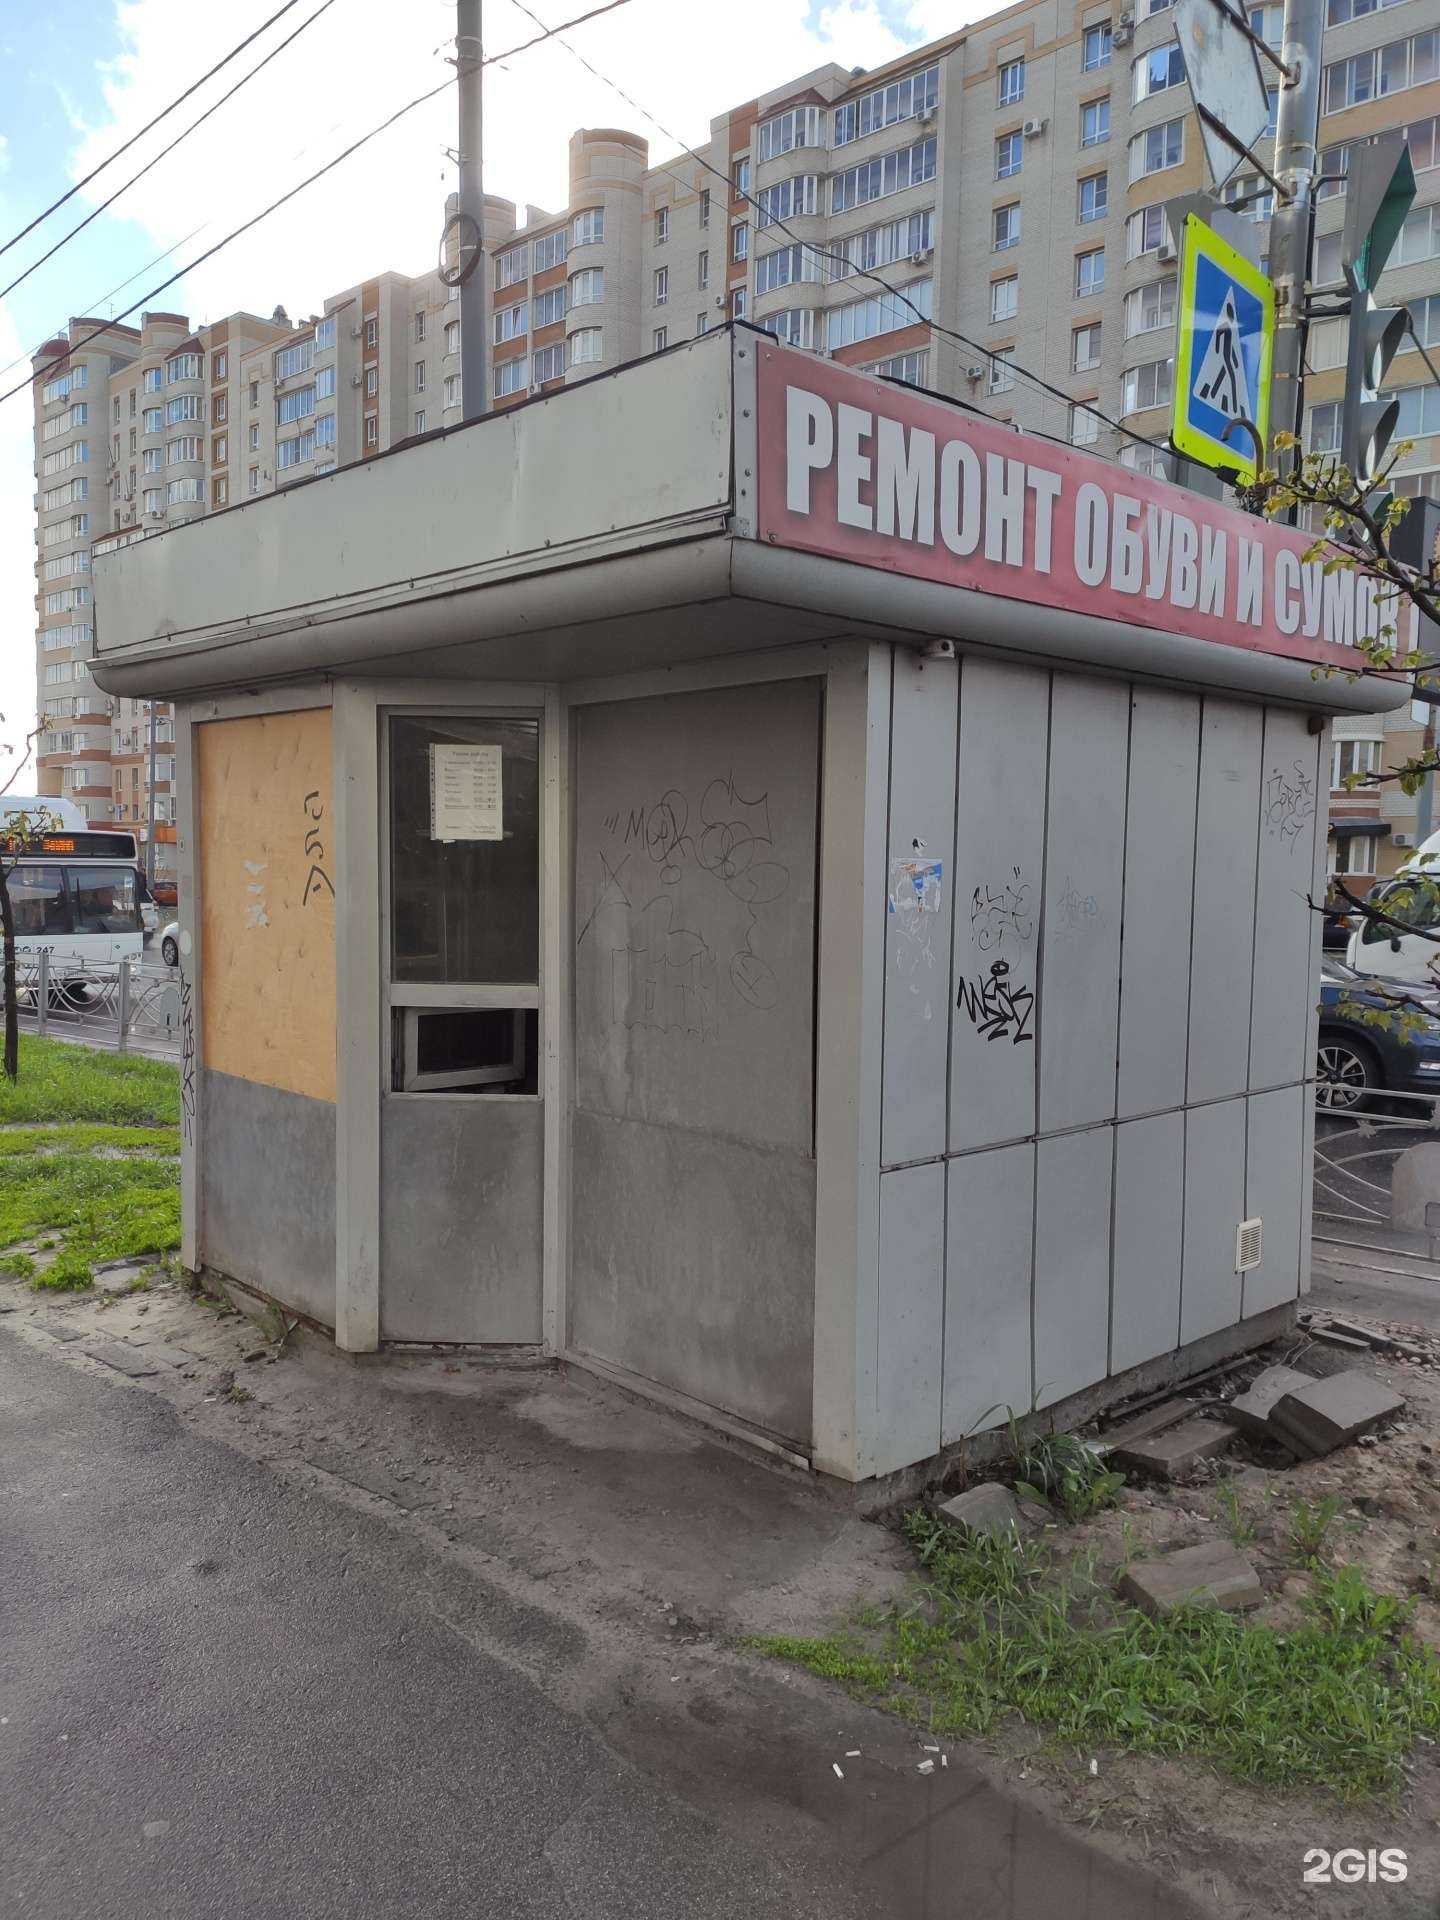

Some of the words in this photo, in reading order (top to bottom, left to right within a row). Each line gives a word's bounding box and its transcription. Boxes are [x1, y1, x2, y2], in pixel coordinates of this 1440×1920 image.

[785, 385, 1062, 574] РЕМОНТ
[1073, 482, 1226, 618] ОБУВИ
[1236, 533, 1263, 626] И
